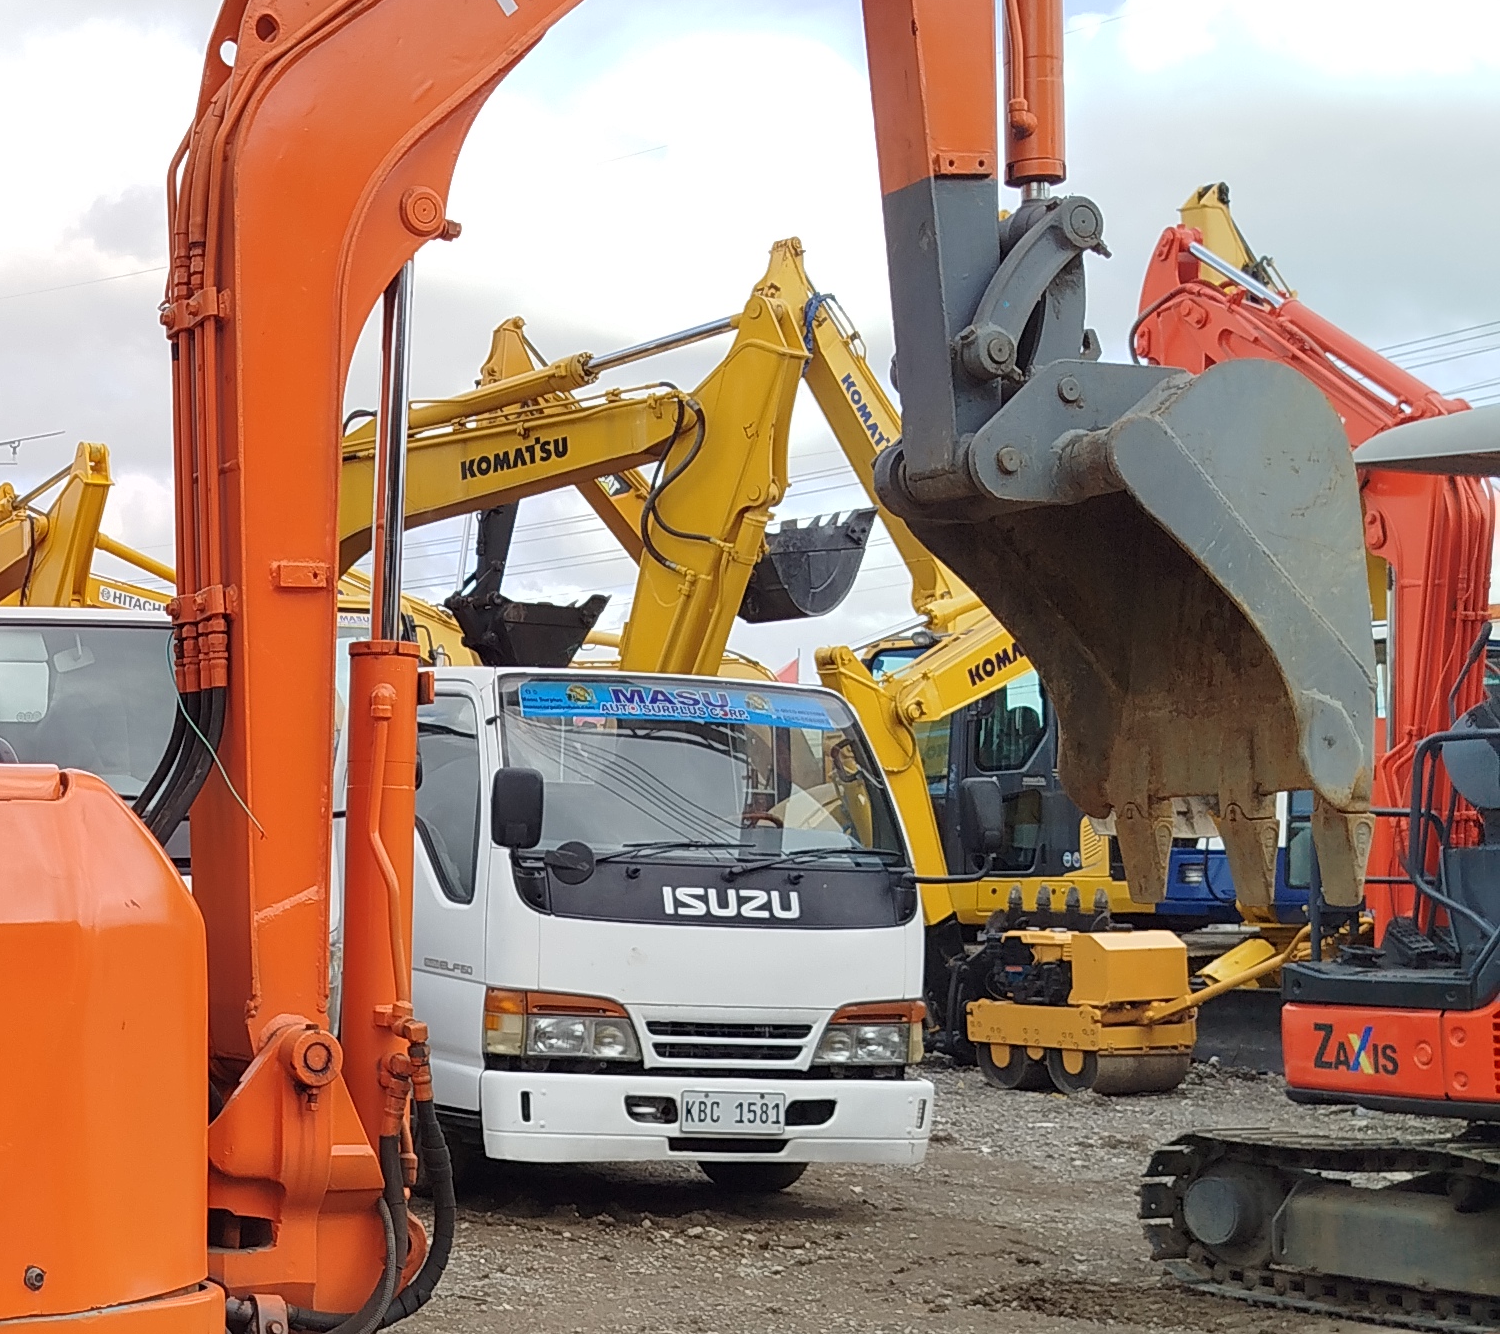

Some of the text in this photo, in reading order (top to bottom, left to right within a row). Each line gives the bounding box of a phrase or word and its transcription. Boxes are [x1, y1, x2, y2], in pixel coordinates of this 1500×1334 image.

[461, 437, 569, 480] KOMATSU
[610, 687, 730, 708] MASU
[644, 704, 706, 716] SURPLUS
[710, 707, 749, 719] CORP.
[662, 886, 800, 919] ISUZU
[1313, 1022, 1399, 1077] ZAXIS
[684, 1100, 782, 1125] KBC 1581
